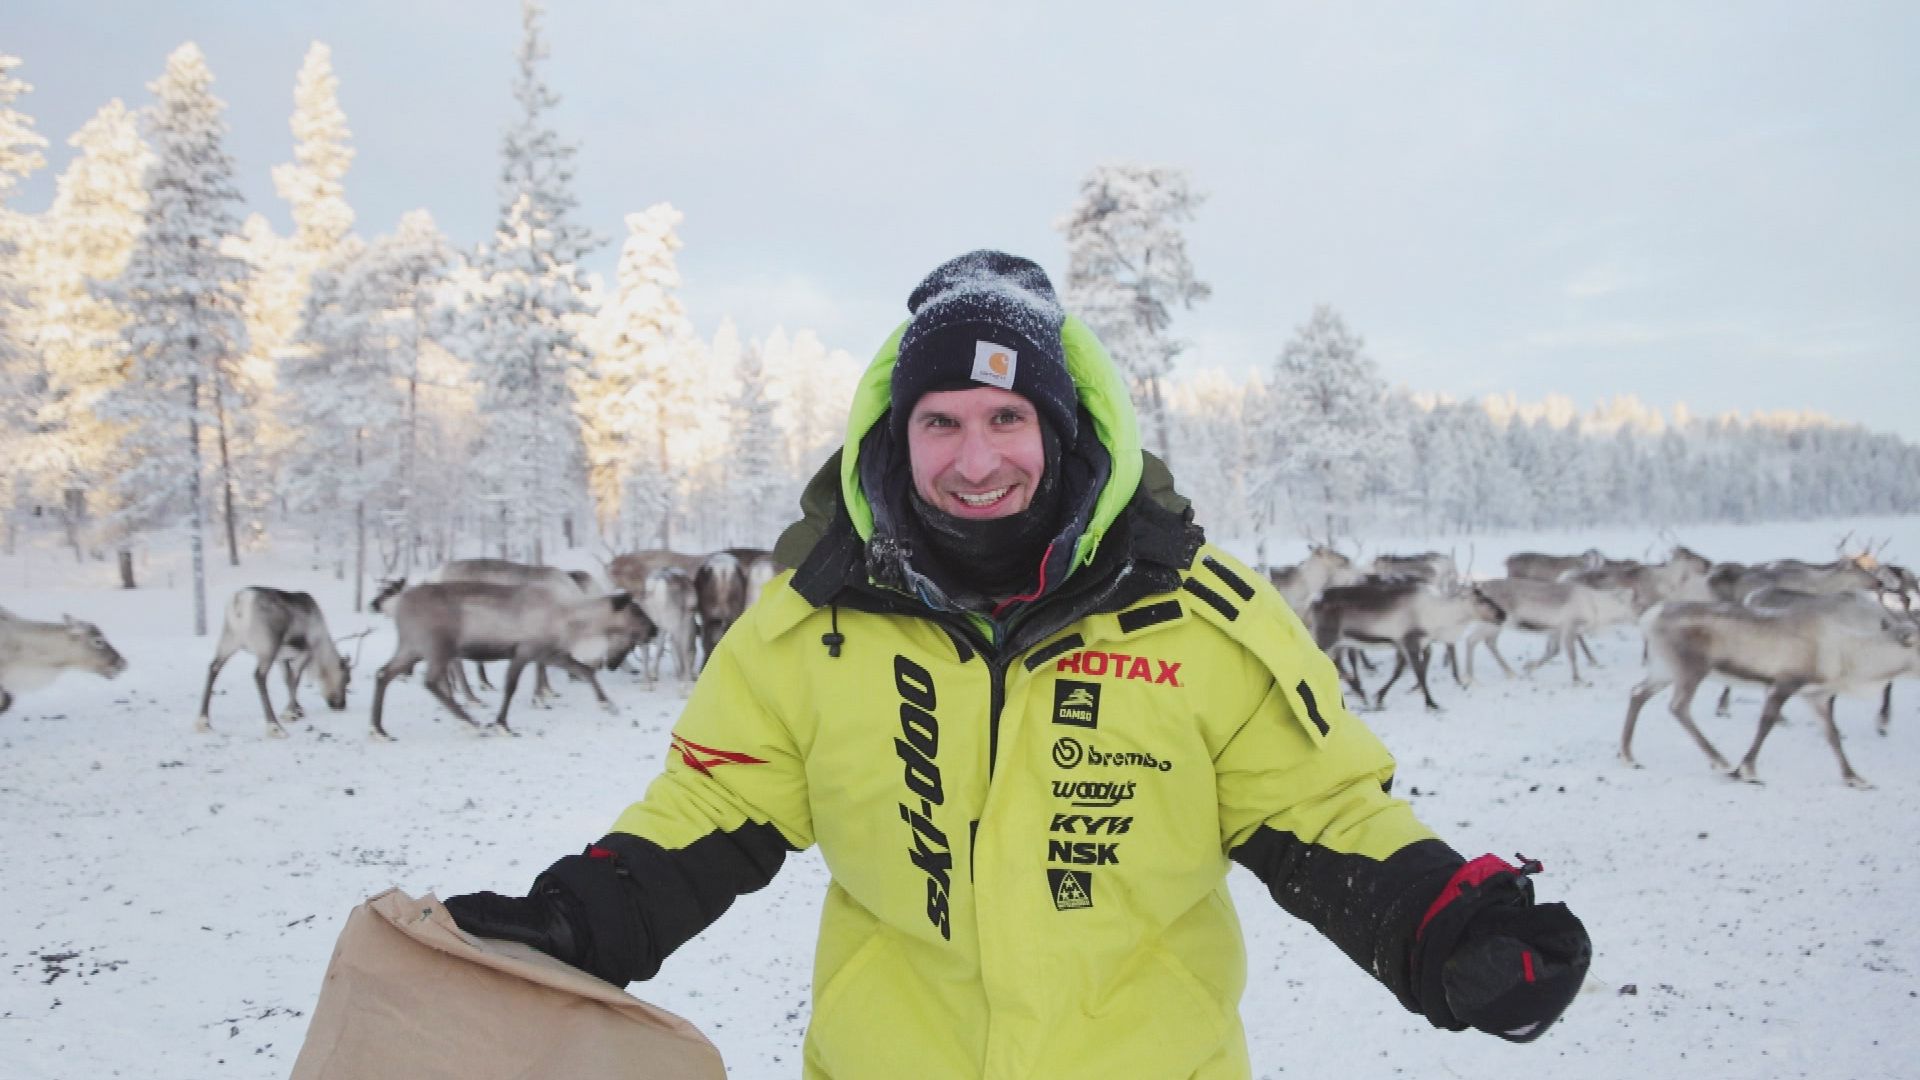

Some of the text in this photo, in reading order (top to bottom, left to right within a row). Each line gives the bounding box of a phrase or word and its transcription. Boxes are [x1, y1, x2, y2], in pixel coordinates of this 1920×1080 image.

[1056, 651, 1182, 687] ROTAX
[1088, 745, 1172, 772] brembo
[893, 654, 952, 941] ski-doo
[1049, 813, 1134, 835] KYB
[1048, 840, 1120, 865] NSK
